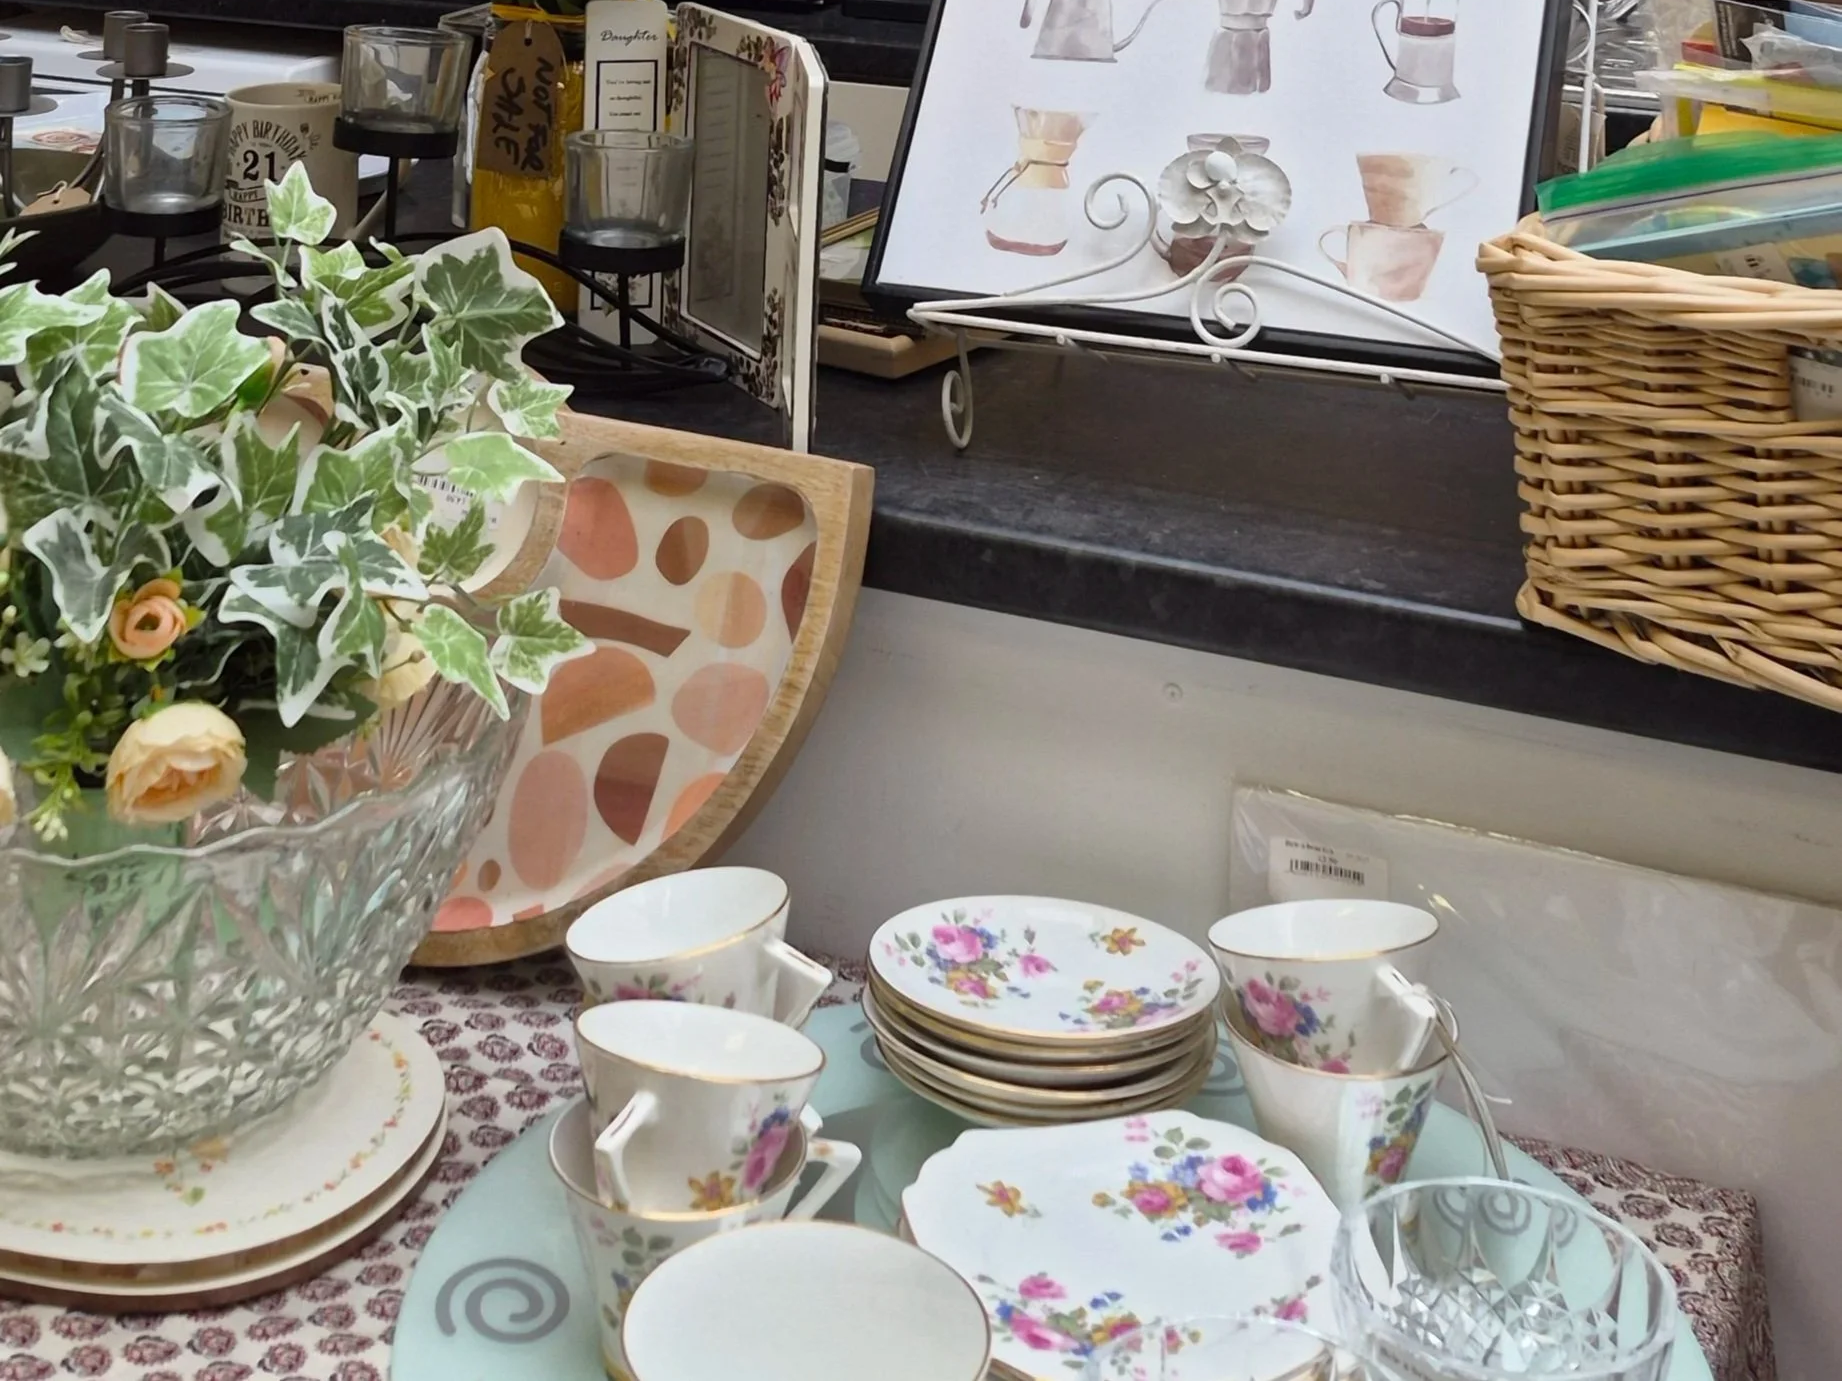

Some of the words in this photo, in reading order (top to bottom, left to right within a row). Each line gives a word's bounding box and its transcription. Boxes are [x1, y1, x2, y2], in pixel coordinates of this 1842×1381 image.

[600, 29, 659, 47] Daughter
[532, 55, 555, 126] NOT
[491, 66, 527, 166] SALE
[252, 119, 309, 162] BIRTHDAY
[521, 122, 547, 172] FOR
[242, 149, 278, 183] 21
